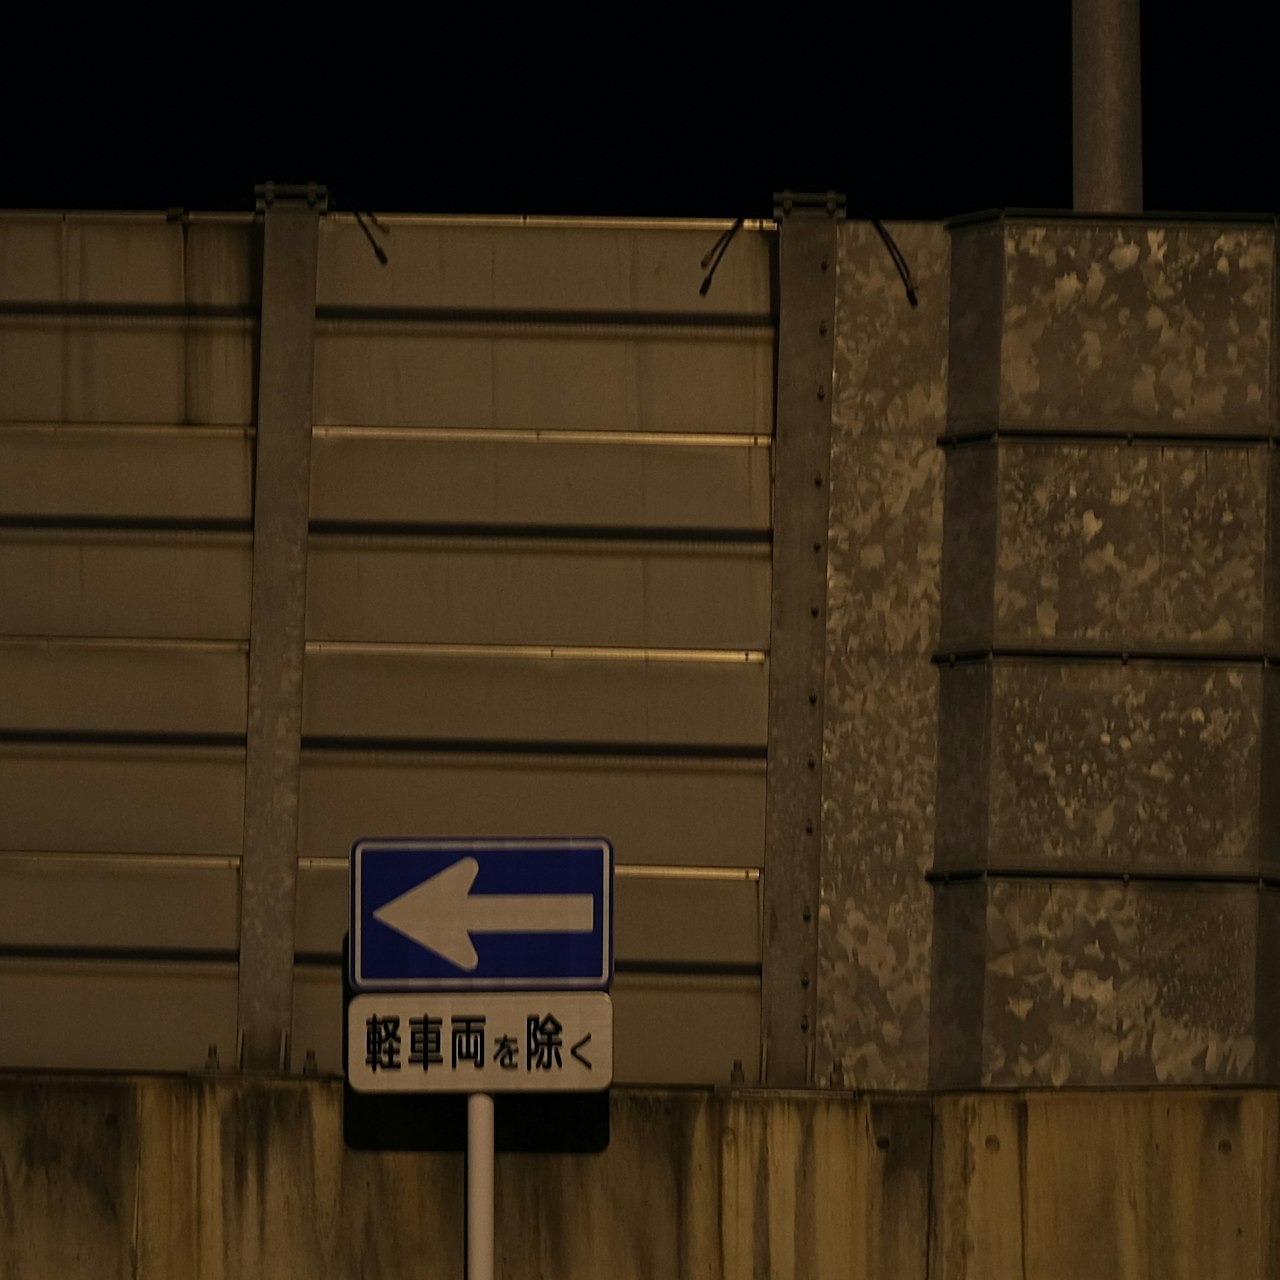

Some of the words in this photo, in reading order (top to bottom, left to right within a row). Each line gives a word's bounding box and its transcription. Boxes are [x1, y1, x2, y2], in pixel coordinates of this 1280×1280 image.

[365, 1014, 592, 1071] 軽車両を除く
